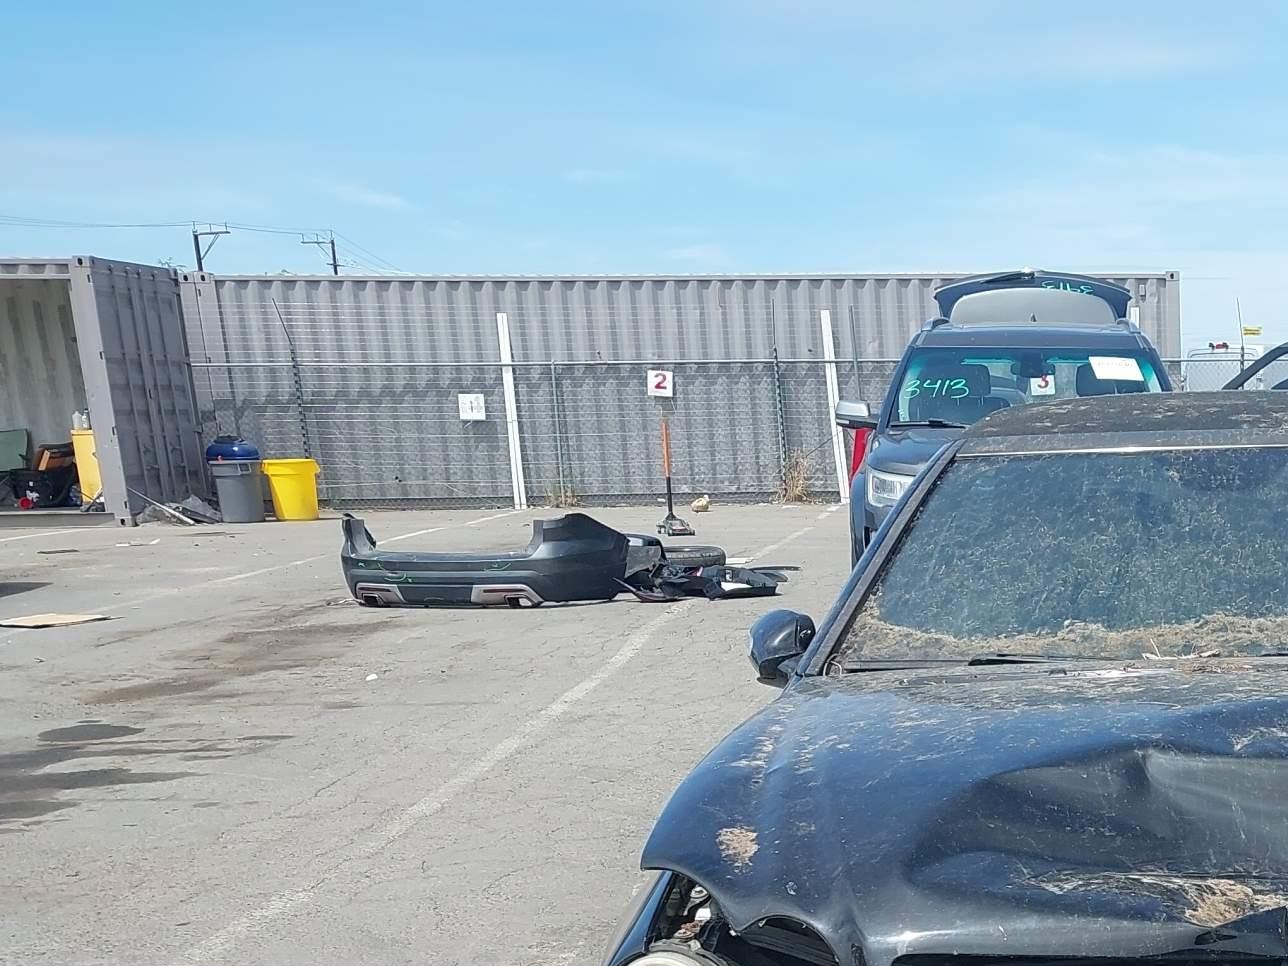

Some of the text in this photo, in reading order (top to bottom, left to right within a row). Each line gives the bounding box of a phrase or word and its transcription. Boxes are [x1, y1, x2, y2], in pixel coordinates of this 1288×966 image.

[653, 372, 668, 390] 2
[903, 379, 970, 399] 3413
[1037, 374, 1050, 389] 3
